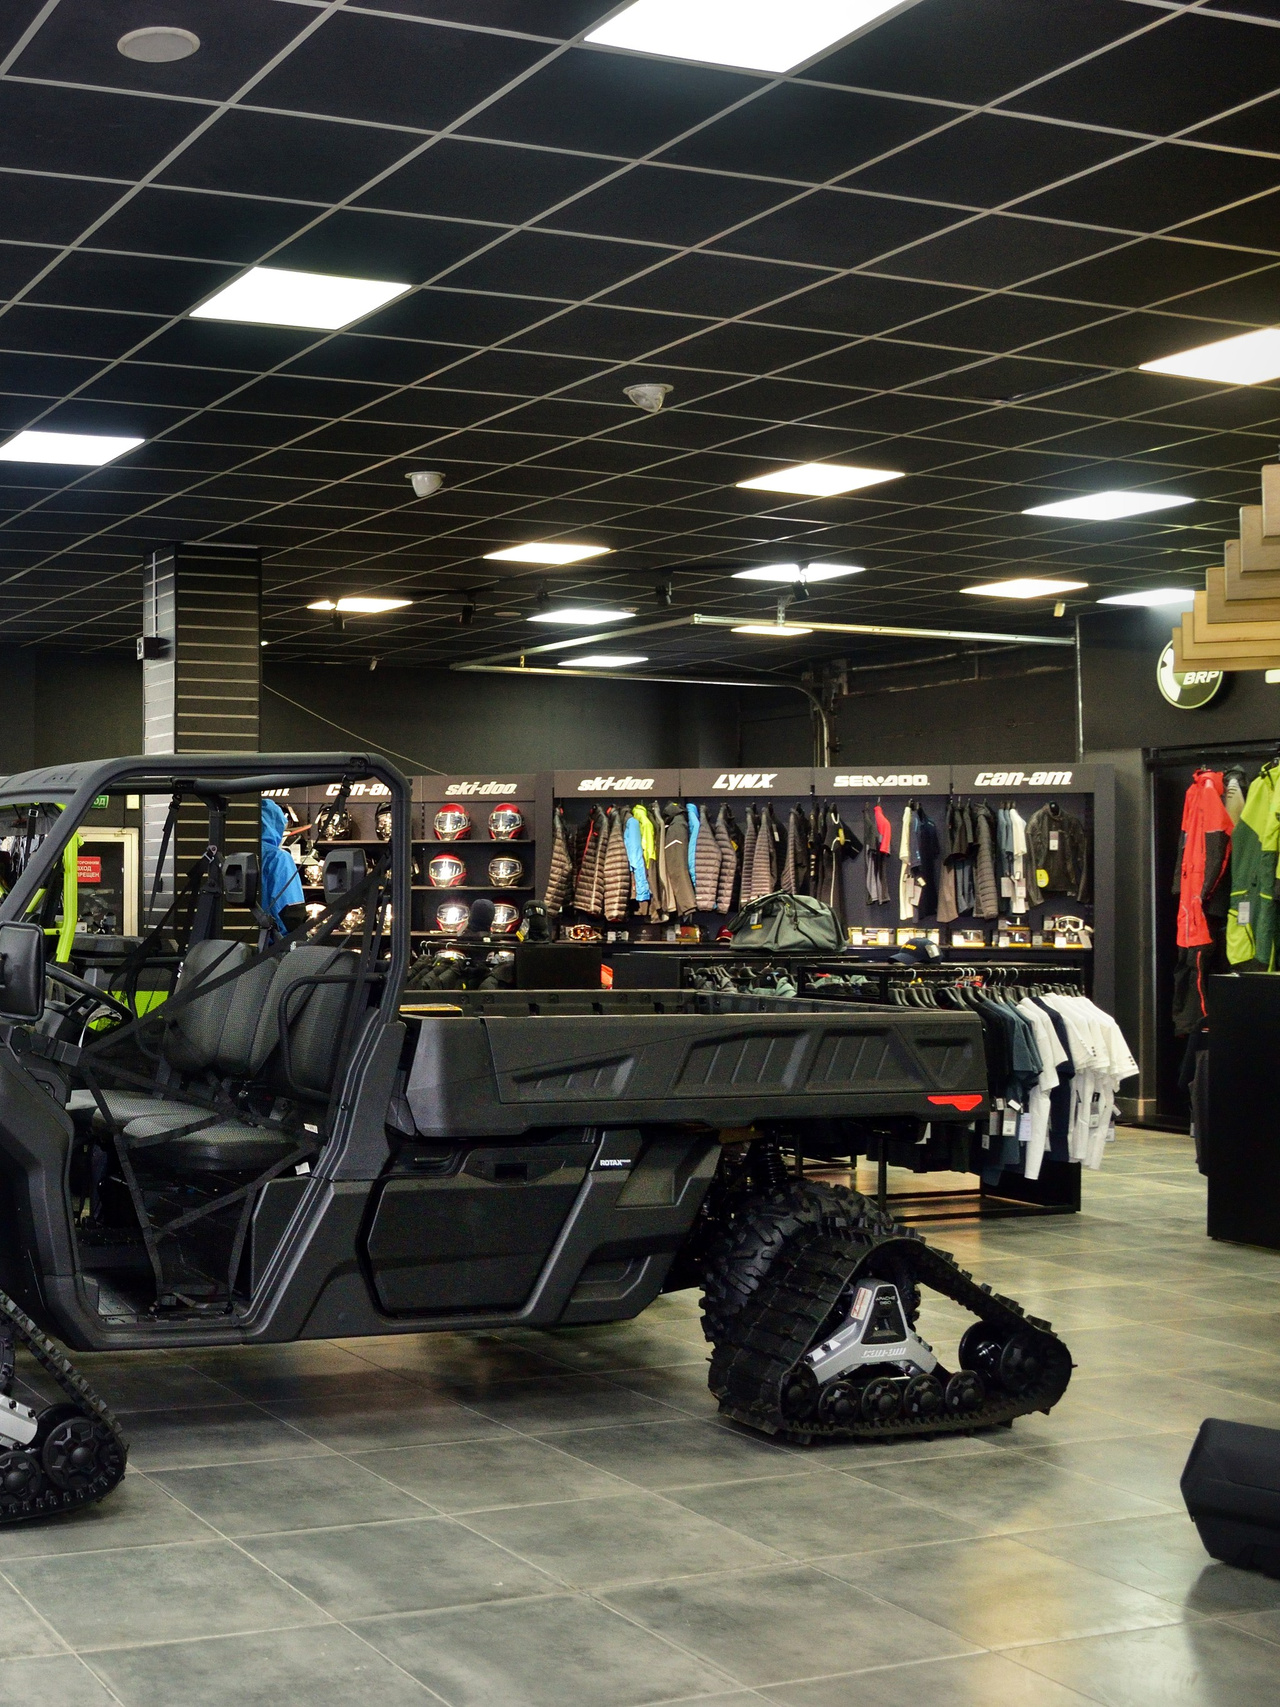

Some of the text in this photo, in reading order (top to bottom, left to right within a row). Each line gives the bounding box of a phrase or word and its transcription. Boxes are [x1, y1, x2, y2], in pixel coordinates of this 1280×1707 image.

[1182, 671, 1219, 685] BRP
[577, 776, 655, 791] ski-doo
[711, 773, 778, 790] LYNX
[974, 771, 1073, 786] can-am
[444, 781, 518, 795] ski-doo
